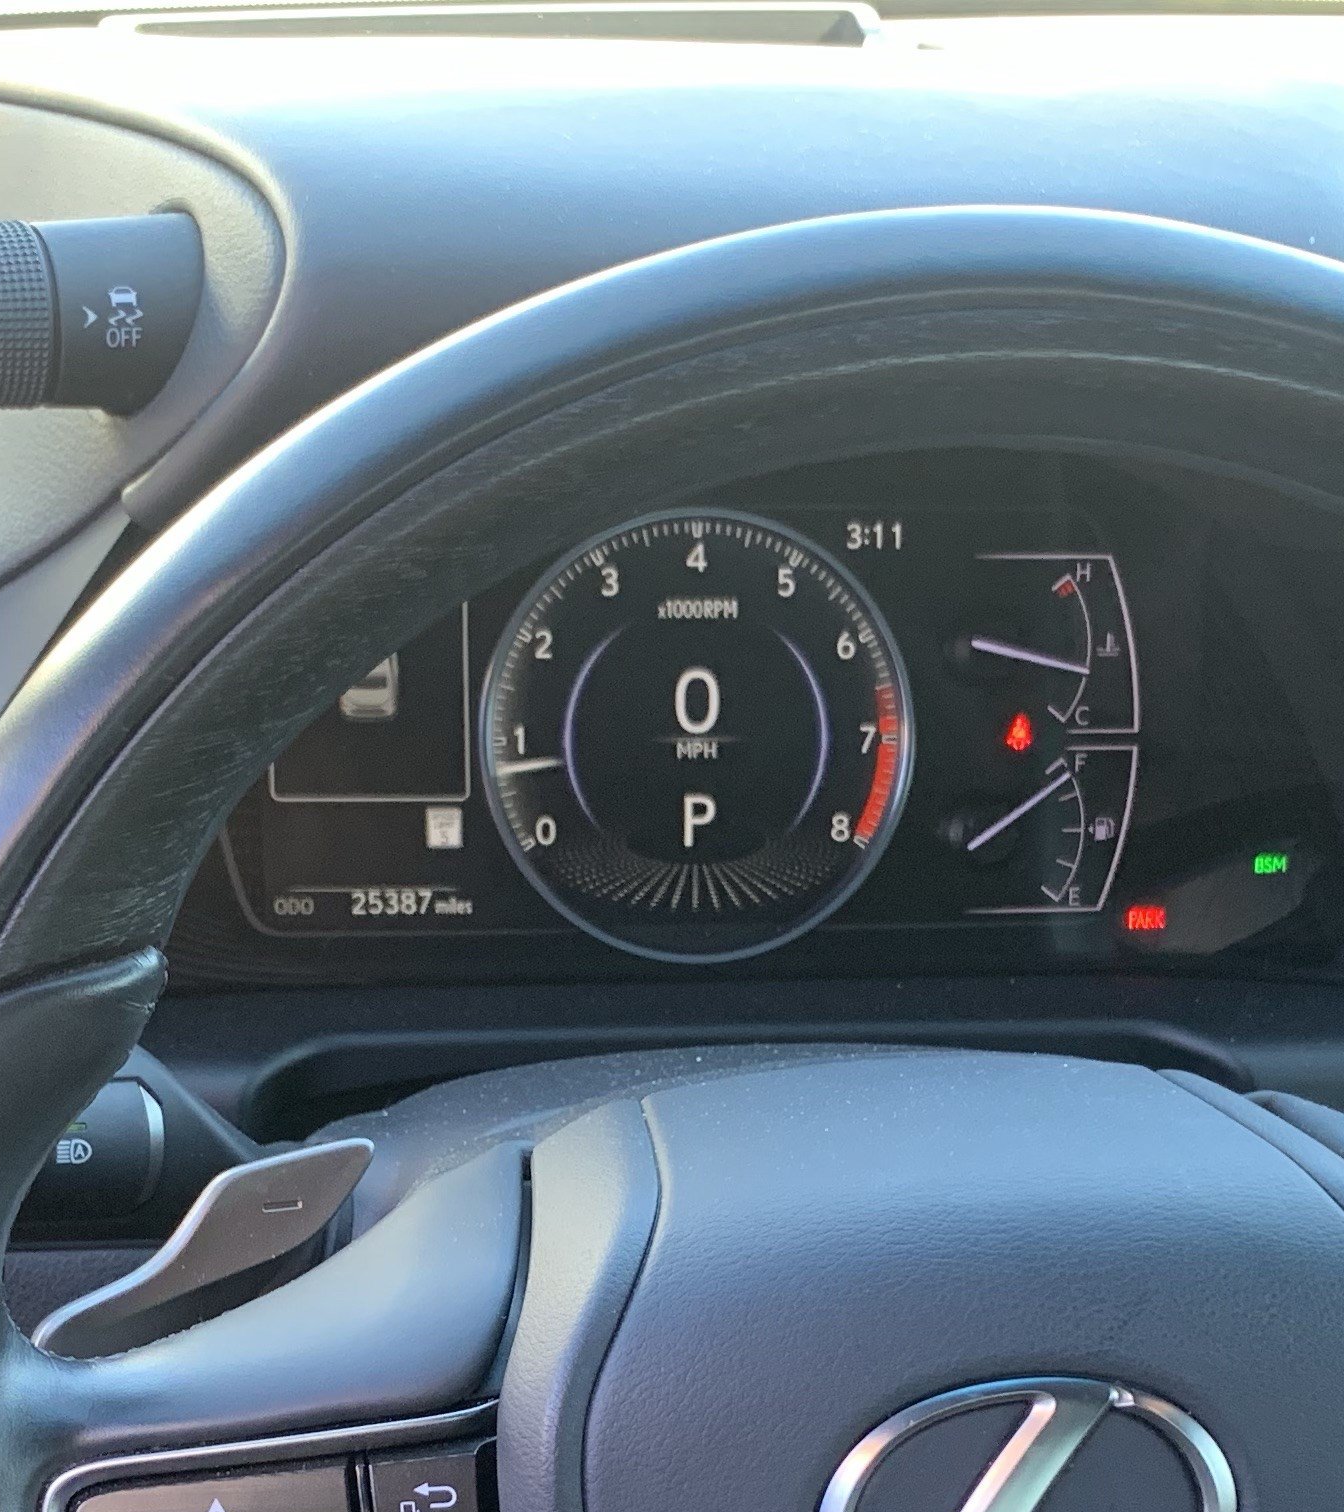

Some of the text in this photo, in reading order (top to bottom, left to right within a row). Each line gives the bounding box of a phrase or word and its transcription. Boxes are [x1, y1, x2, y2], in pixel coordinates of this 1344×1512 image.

[106, 327, 143, 348] OFF
[846, 522, 903, 549] 3:11
[686, 545, 708, 572] 4
[602, 567, 619, 597] 3
[778, 568, 796, 597] 5
[1076, 562, 1091, 583] H
[658, 599, 738, 619] x1000RPM
[534, 631, 553, 659] 2
[837, 631, 856, 660] 6
[675, 667, 720, 734] 0
[1075, 706, 1089, 726] C
[513, 727, 526, 754] 1
[676, 742, 719, 759] MPH
[859, 726, 877, 754] 7
[1074, 753, 1088, 772] F
[535, 815, 557, 846] 0
[683, 794, 717, 848] P
[831, 812, 851, 843] 8
[273, 888, 473, 915] ODO 25387 miles
[1068, 887, 1080, 906] E
